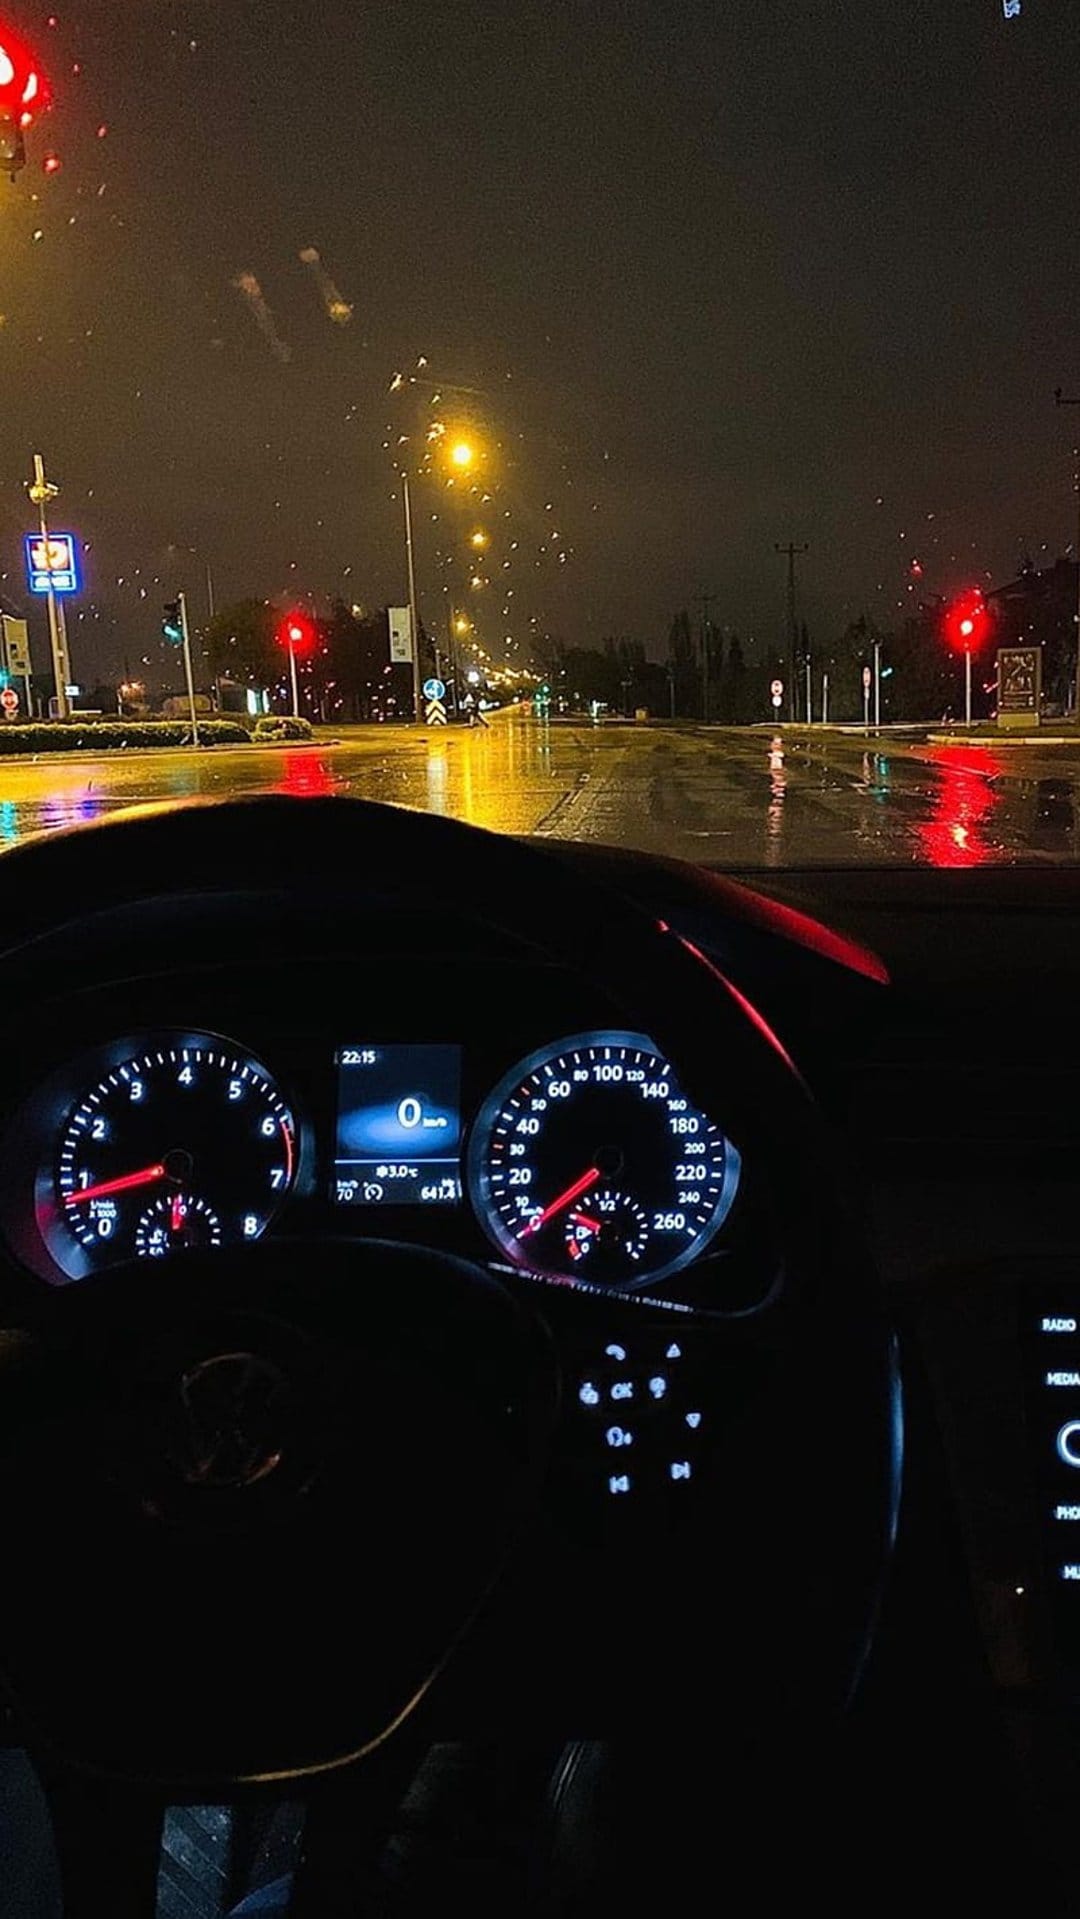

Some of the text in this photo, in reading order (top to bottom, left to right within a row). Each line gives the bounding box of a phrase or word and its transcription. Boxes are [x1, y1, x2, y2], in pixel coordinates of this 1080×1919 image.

[342, 1051, 375, 1064] 22:15
[179, 1067, 193, 1085] 4
[574, 1070, 588, 1081] 80
[593, 1065, 623, 1081] 100
[626, 1070, 645, 1082] 120
[129, 1082, 142, 1099] 3
[228, 1082, 241, 1099] 5
[548, 1081, 571, 1098] 60
[639, 1081, 669, 1098] 140
[398, 1098, 421, 1128] 0
[531, 1099, 547, 1111] 50
[667, 1099, 687, 1111] 160
[91, 1119, 105, 1138] 2
[262, 1116, 275, 1135] 6
[516, 1118, 539, 1134] 40
[669, 1118, 699, 1134] 180
[510, 1144, 525, 1155] 30
[684, 1143, 705, 1155] 200
[79, 1171, 88, 1190] 1
[270, 1169, 283, 1187] 7
[509, 1168, 532, 1185] 20
[675, 1165, 706, 1181] 220
[337, 1189, 352, 1201] 70
[421, 1186, 455, 1200] 641.4
[679, 1192, 701, 1204] 240
[515, 1196, 529, 1208] 10
[599, 1199, 617, 1212] 1/2
[98, 1218, 111, 1236] 0
[244, 1216, 258, 1236] 8
[653, 1214, 685, 1230] 260
[581, 1242, 590, 1254] 0
[1042, 1318, 1077, 1332] RADIO
[1046, 1372, 1080, 1386] MEDIA
[610, 1382, 633, 1399] OK
